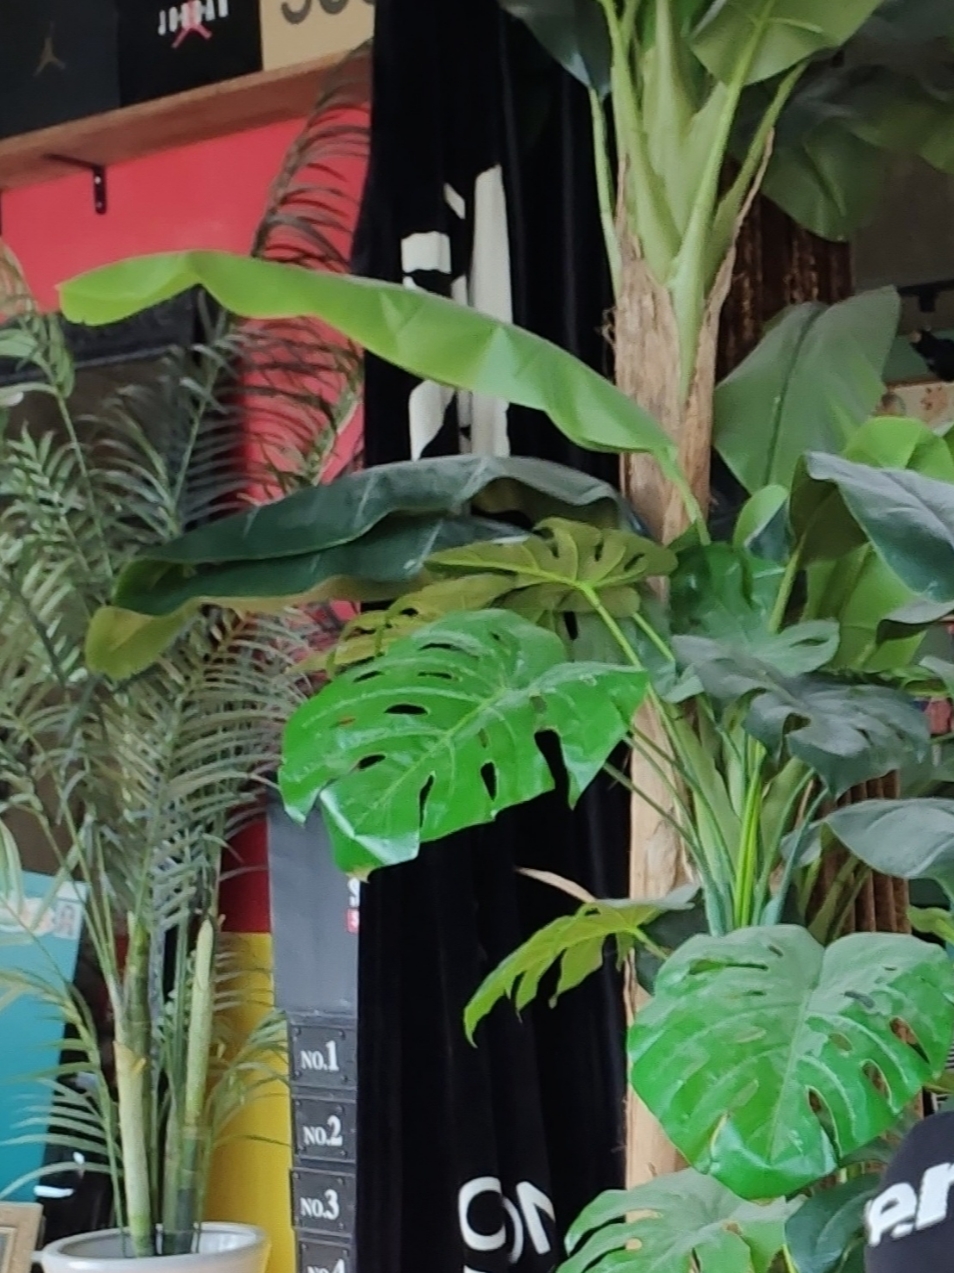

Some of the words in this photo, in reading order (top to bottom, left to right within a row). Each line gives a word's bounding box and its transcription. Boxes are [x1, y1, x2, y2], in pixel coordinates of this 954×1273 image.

[300, 1040, 339, 1071] NO.1
[302, 1115, 343, 1147] NO.2
[299, 1189, 340, 1221] NO.3
